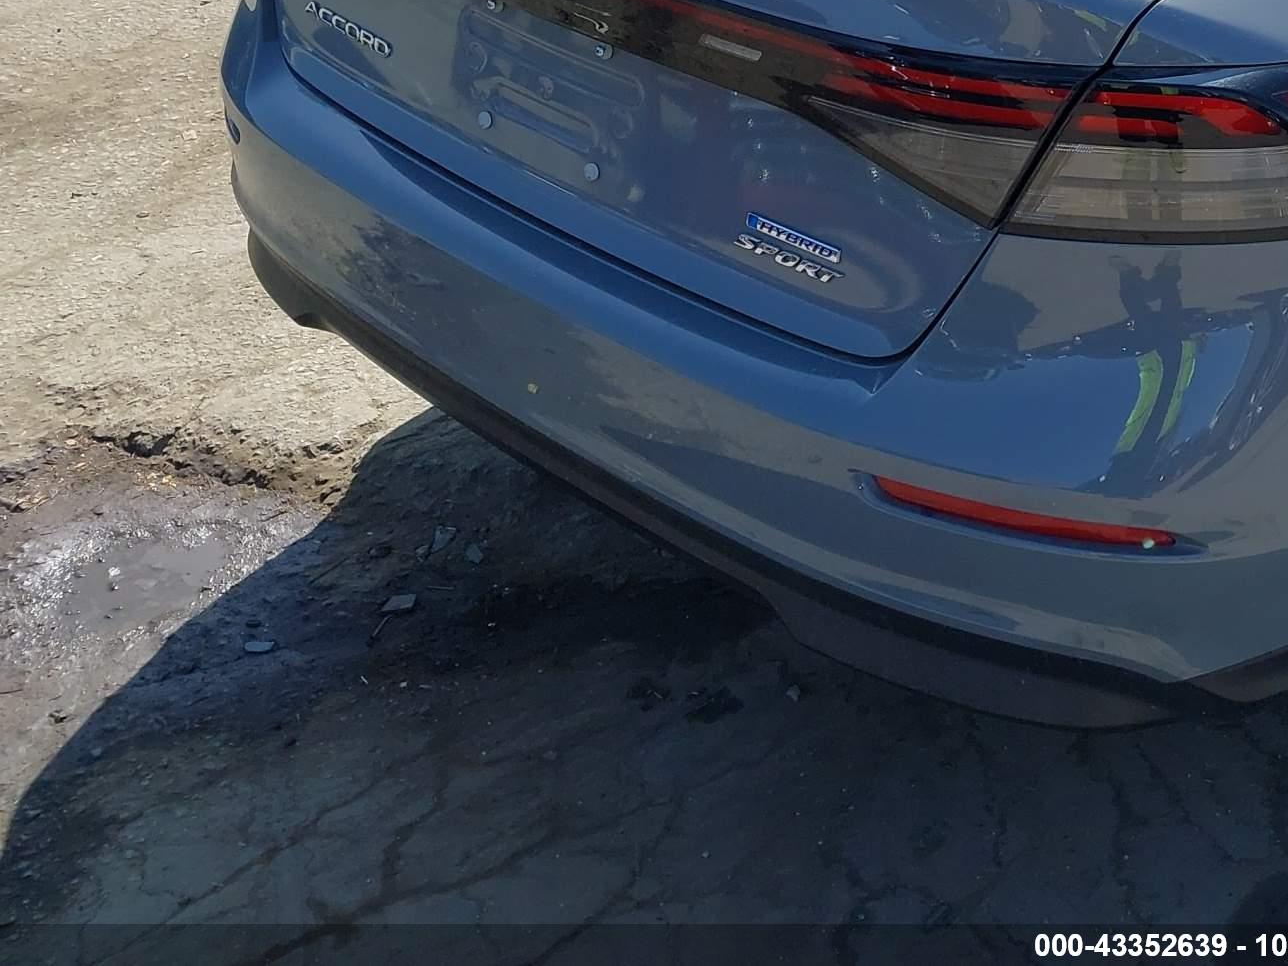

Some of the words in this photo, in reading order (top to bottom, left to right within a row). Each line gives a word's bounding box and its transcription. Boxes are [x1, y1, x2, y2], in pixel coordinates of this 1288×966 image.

[304, 0, 392, 58] ACCORD
[733, 233, 846, 283] SPORT
[756, 219, 837, 259] HYBRID
